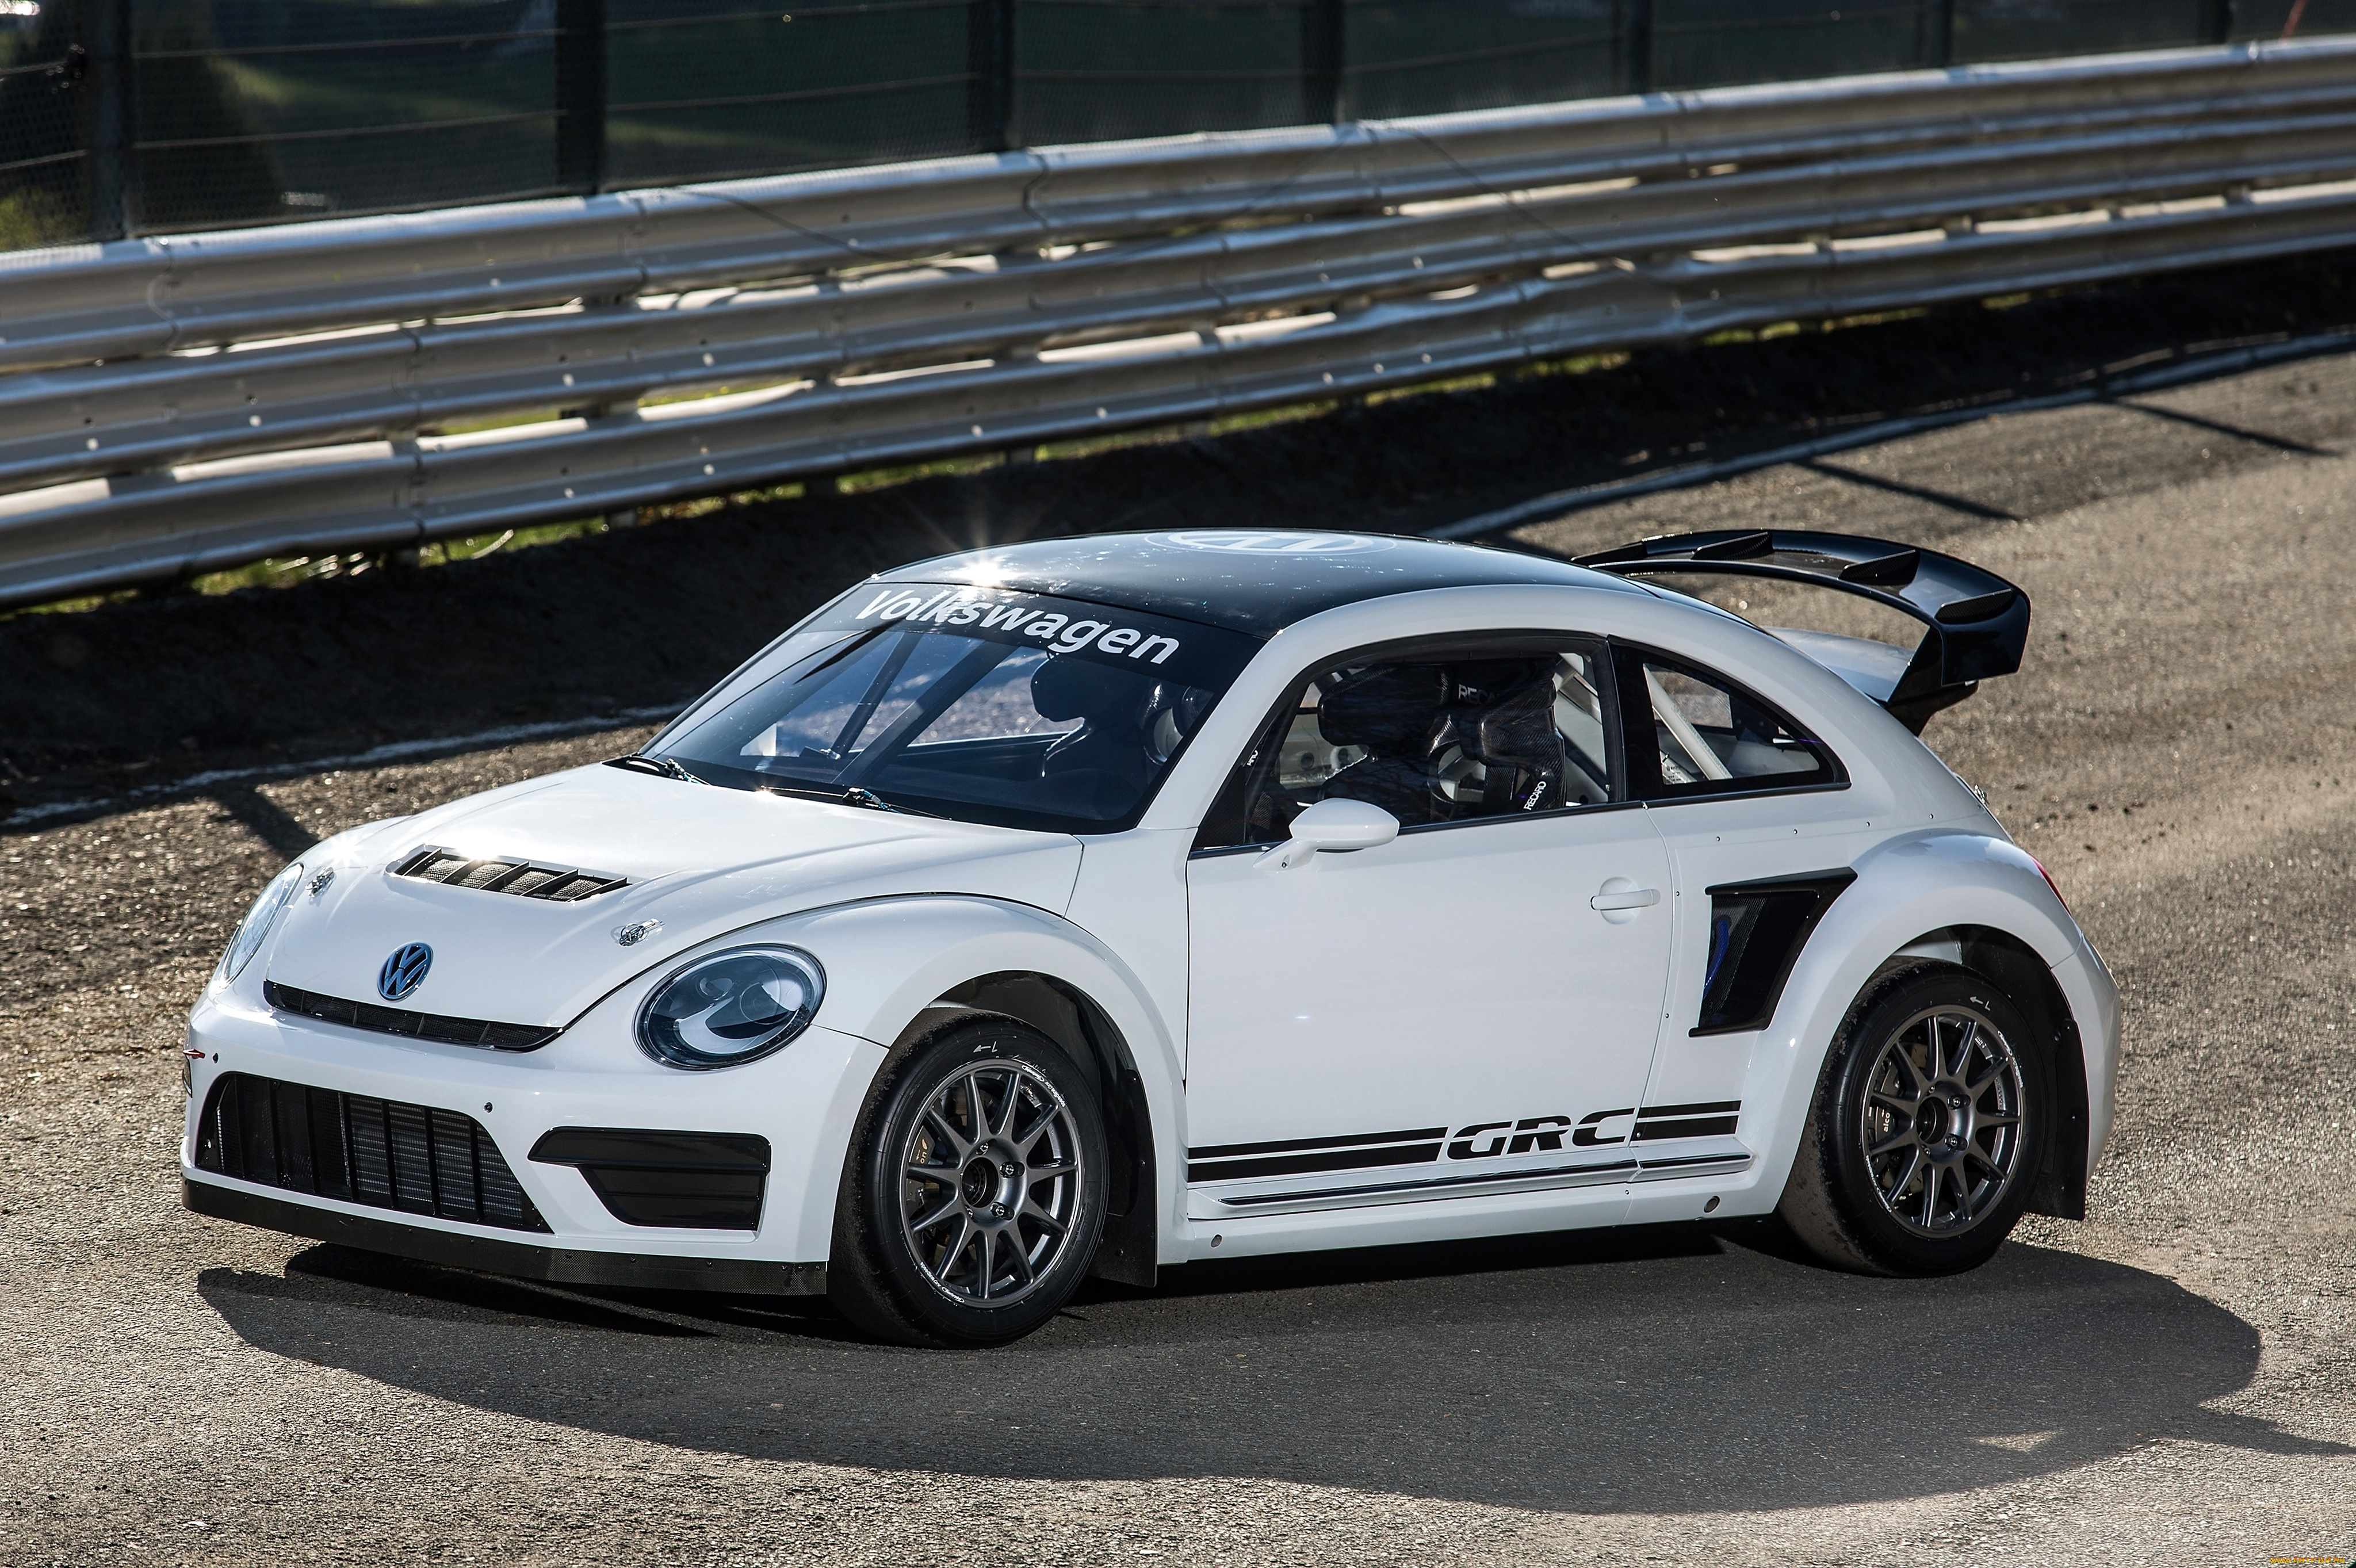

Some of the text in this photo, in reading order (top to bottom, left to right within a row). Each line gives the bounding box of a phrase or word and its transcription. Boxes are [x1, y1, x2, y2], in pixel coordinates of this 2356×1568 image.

[855, 590, 1180, 664] Volkswagen
[1523, 781, 1547, 811] RECARO
[1447, 1107, 1635, 1160] GRC
